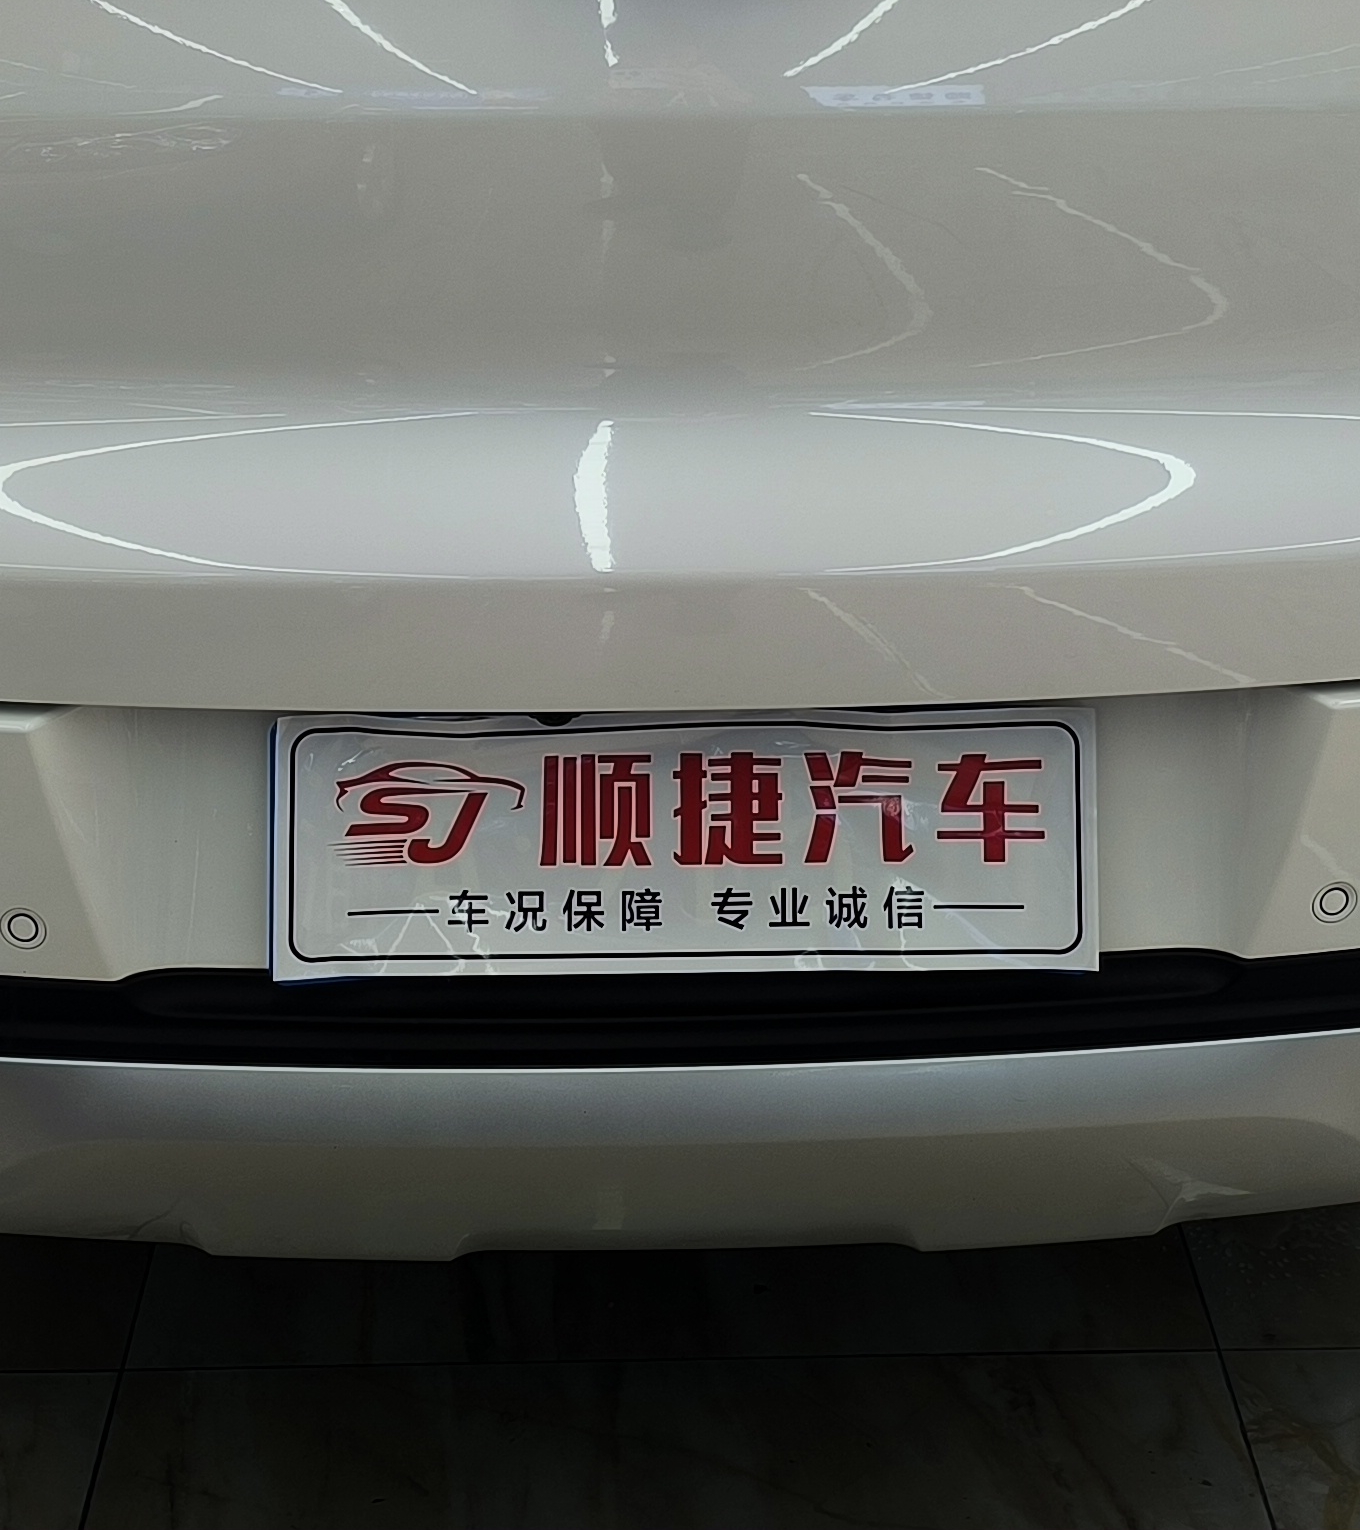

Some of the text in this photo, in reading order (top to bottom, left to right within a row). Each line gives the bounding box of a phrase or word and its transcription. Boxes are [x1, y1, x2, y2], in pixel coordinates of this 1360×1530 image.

[540, 751, 1046, 867] 顺捷汽车
[446, 885, 928, 933] 车况保障 专业诚信
